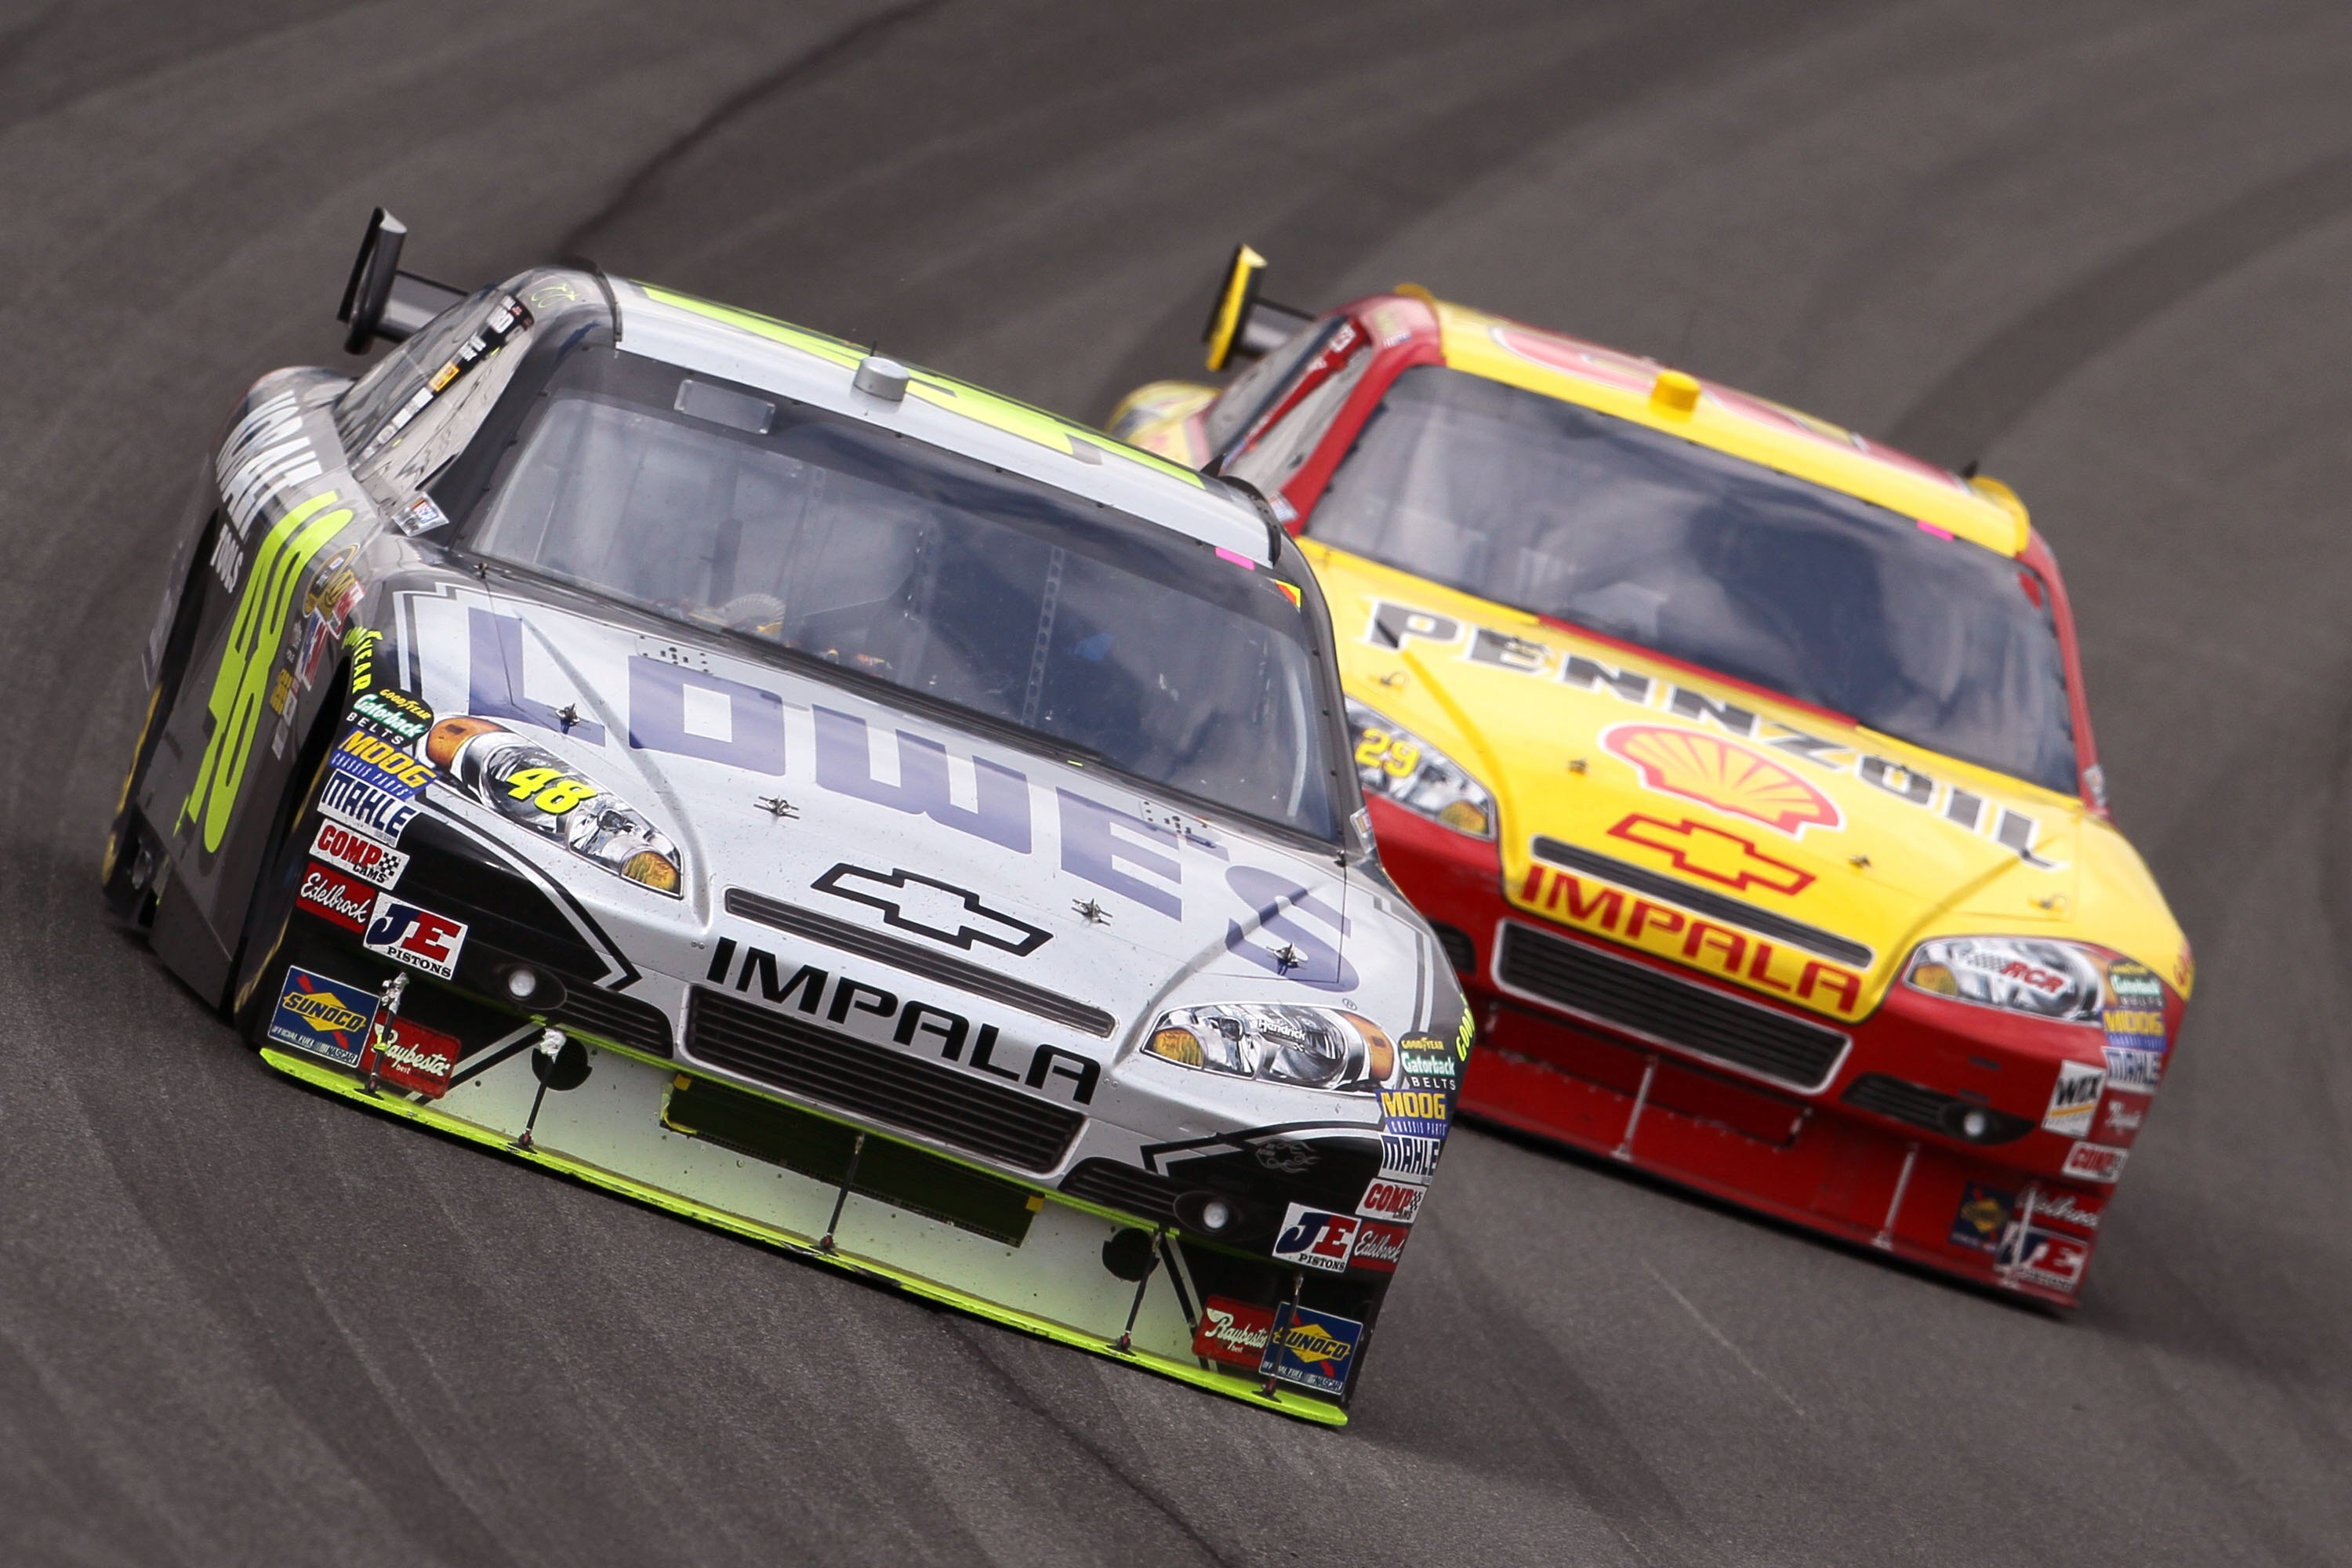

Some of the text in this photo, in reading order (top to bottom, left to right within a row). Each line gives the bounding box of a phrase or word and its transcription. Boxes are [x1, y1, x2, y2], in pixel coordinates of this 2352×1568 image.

[185, 490, 353, 854] 48
[342, 626, 383, 694] YEAR
[354, 693, 428, 739] Gatorback
[379, 688, 432, 720] GOODYEAR
[346, 712, 405, 746] BELTS
[1363, 599, 2063, 872] PENNZOIL
[330, 753, 409, 797] CHASSIS PARTS
[338, 730, 437, 789] MOOG
[1354, 728, 1421, 779] 29
[321, 770, 417, 838] MAHLE
[468, 606, 1359, 993] LOWE'S
[506, 767, 597, 815] 48
[318, 824, 383, 867] COMP
[353, 863, 387, 884] CAMS
[300, 873, 371, 924] Edelbrock
[365, 902, 462, 964] JE
[1521, 864, 1861, 1013] IMPALA
[387, 946, 452, 978] PISTONS
[2002, 960, 2064, 994] RCR
[283, 993, 365, 1031] SUNOCO
[706, 936, 1102, 1105] IMPALA
[1258, 1018, 1307, 1041] Hendrick
[1456, 993, 1475, 1062] GOOD
[1400, 1036, 1444, 1052] GOODYEAR
[1400, 1051, 1456, 1076] Gatorback
[1411, 1076, 1457, 1091] BELTS
[1380, 1091, 1446, 1120] MOOG
[1381, 1135, 1440, 1176] MAHLE
[1363, 1182, 1414, 1212] COMP
[1276, 1211, 1358, 1259] JE
[1298, 1254, 1345, 1272] PISTONS
[1275, 1326, 1348, 1360] UNOCO
